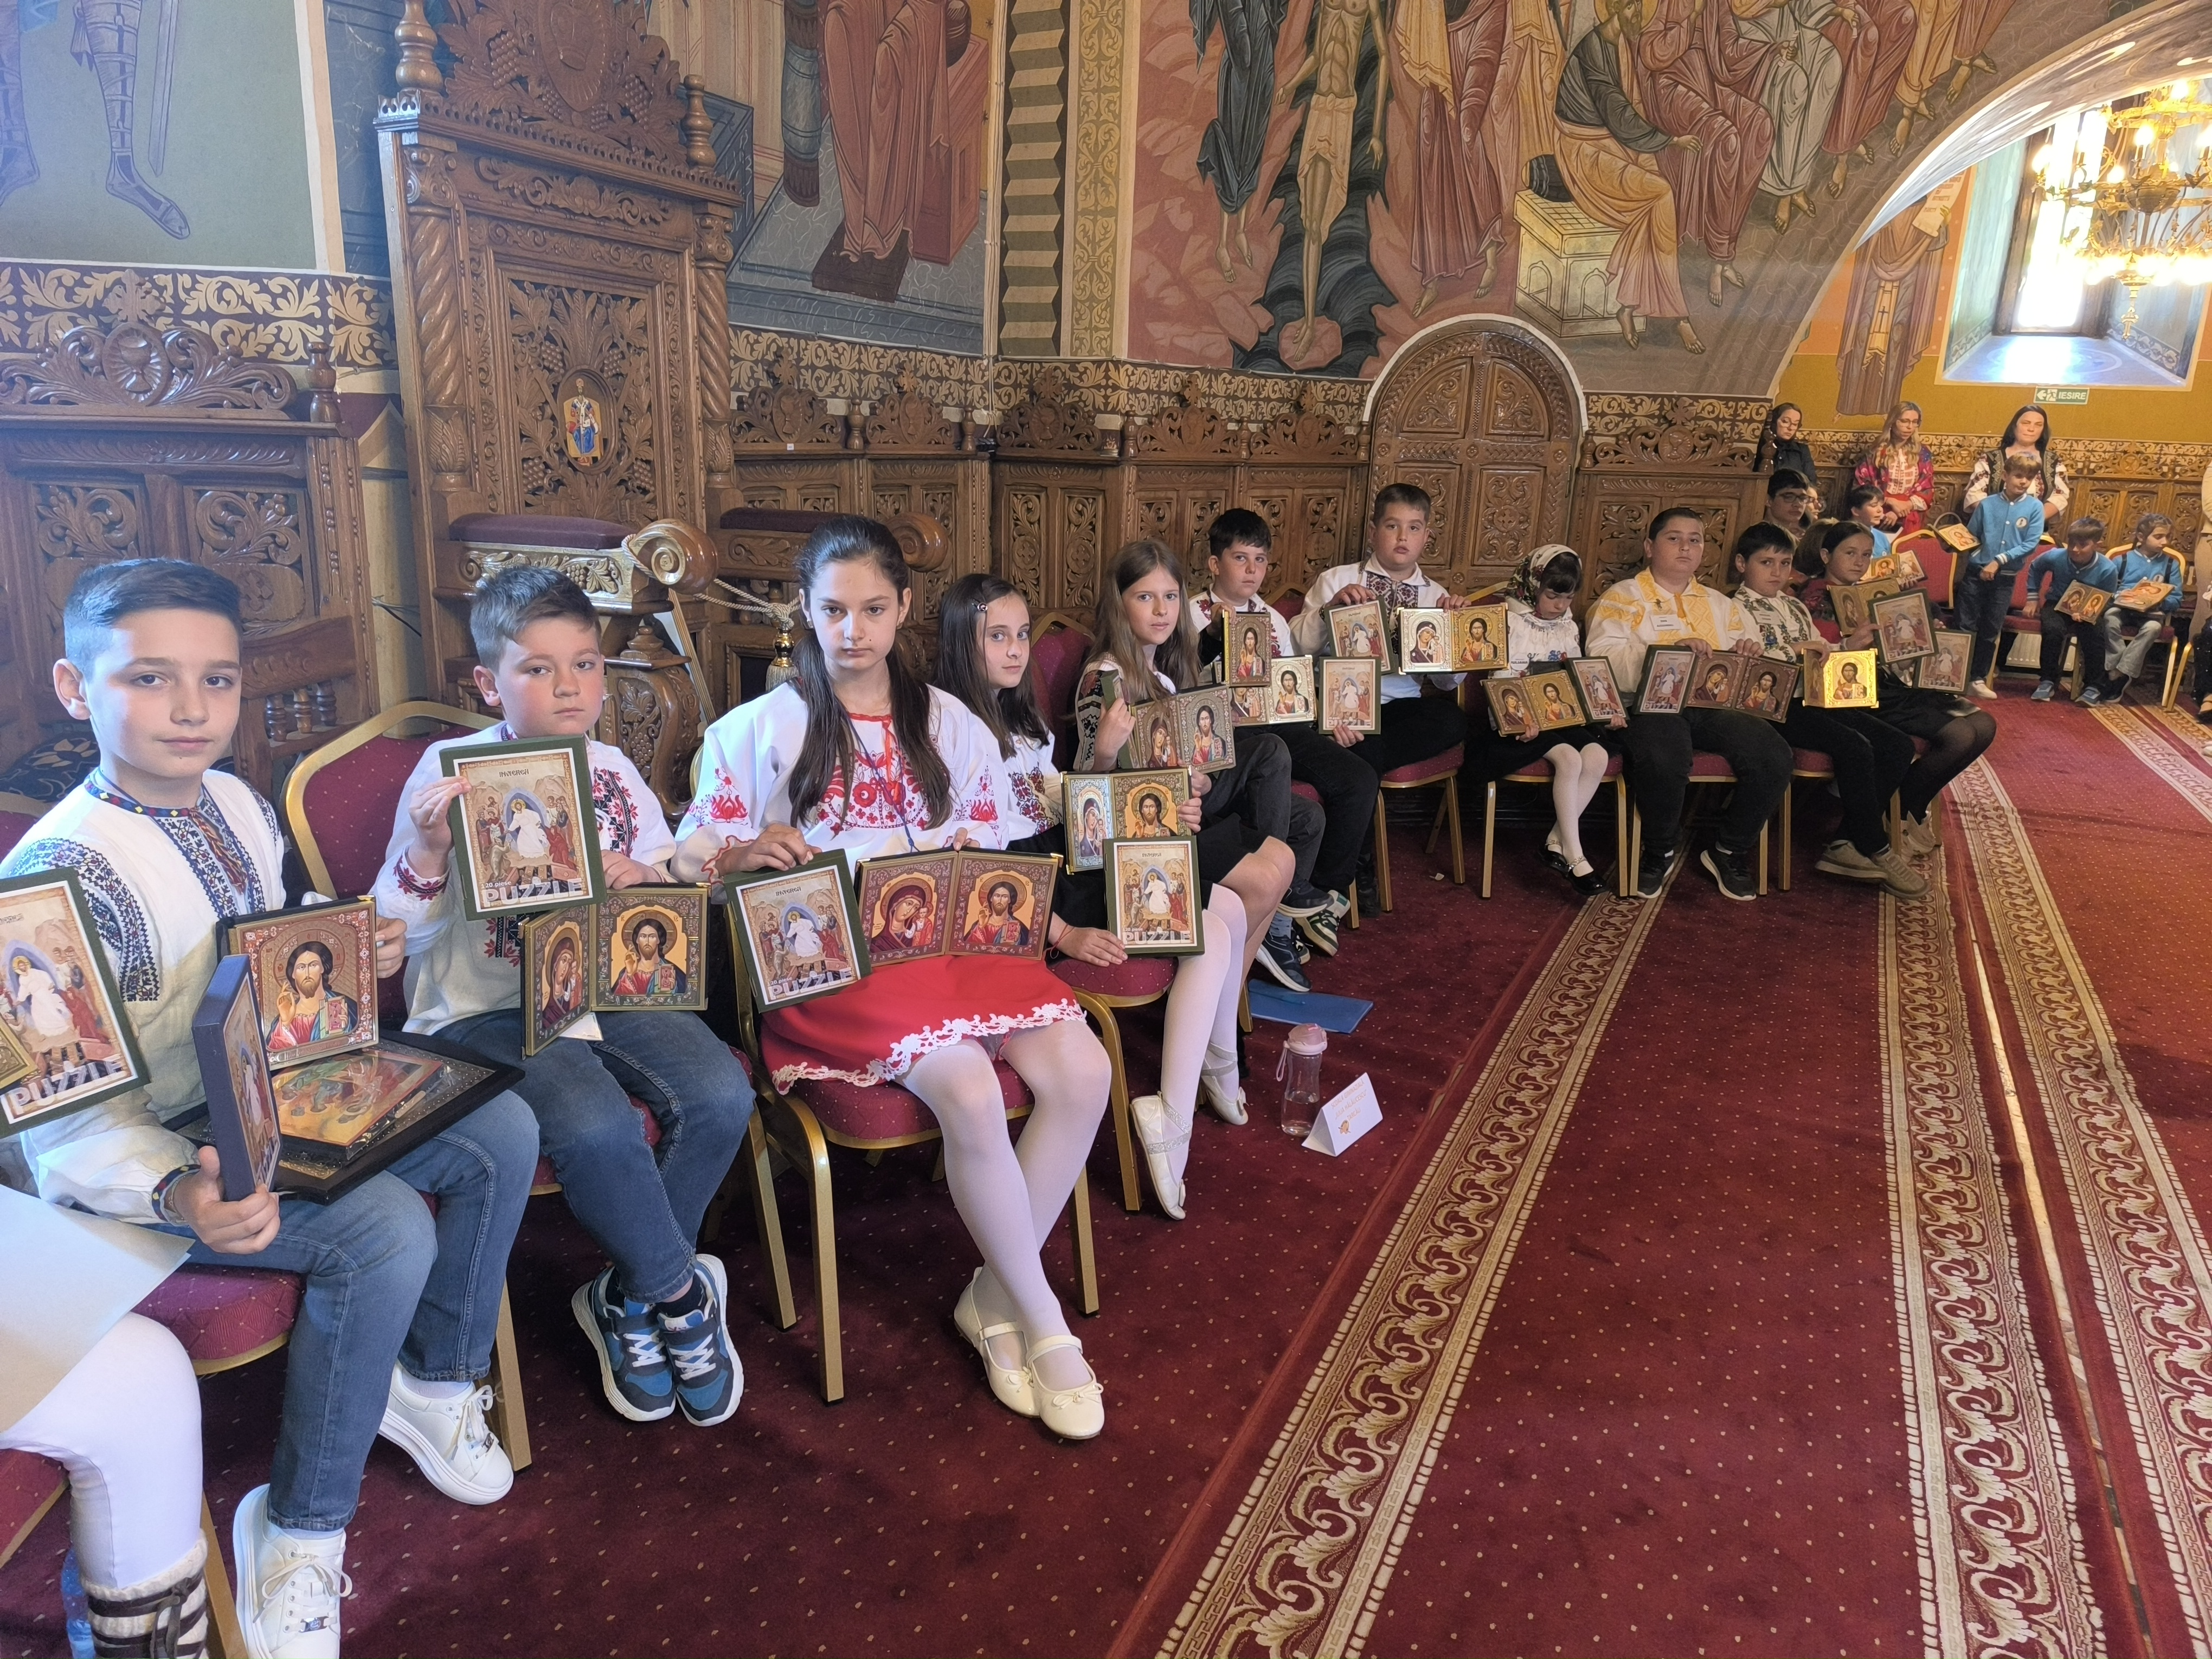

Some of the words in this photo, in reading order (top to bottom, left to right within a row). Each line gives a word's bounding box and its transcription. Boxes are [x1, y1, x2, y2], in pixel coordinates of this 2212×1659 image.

[2058, 391, 2087, 400] IESIRE
[482, 877, 584, 908] PUZZLE
[1122, 930, 1191, 945] PUZZLE
[768, 967, 854, 1000] PUZZLE
[8, 1052, 127, 1115] PUZZLE
